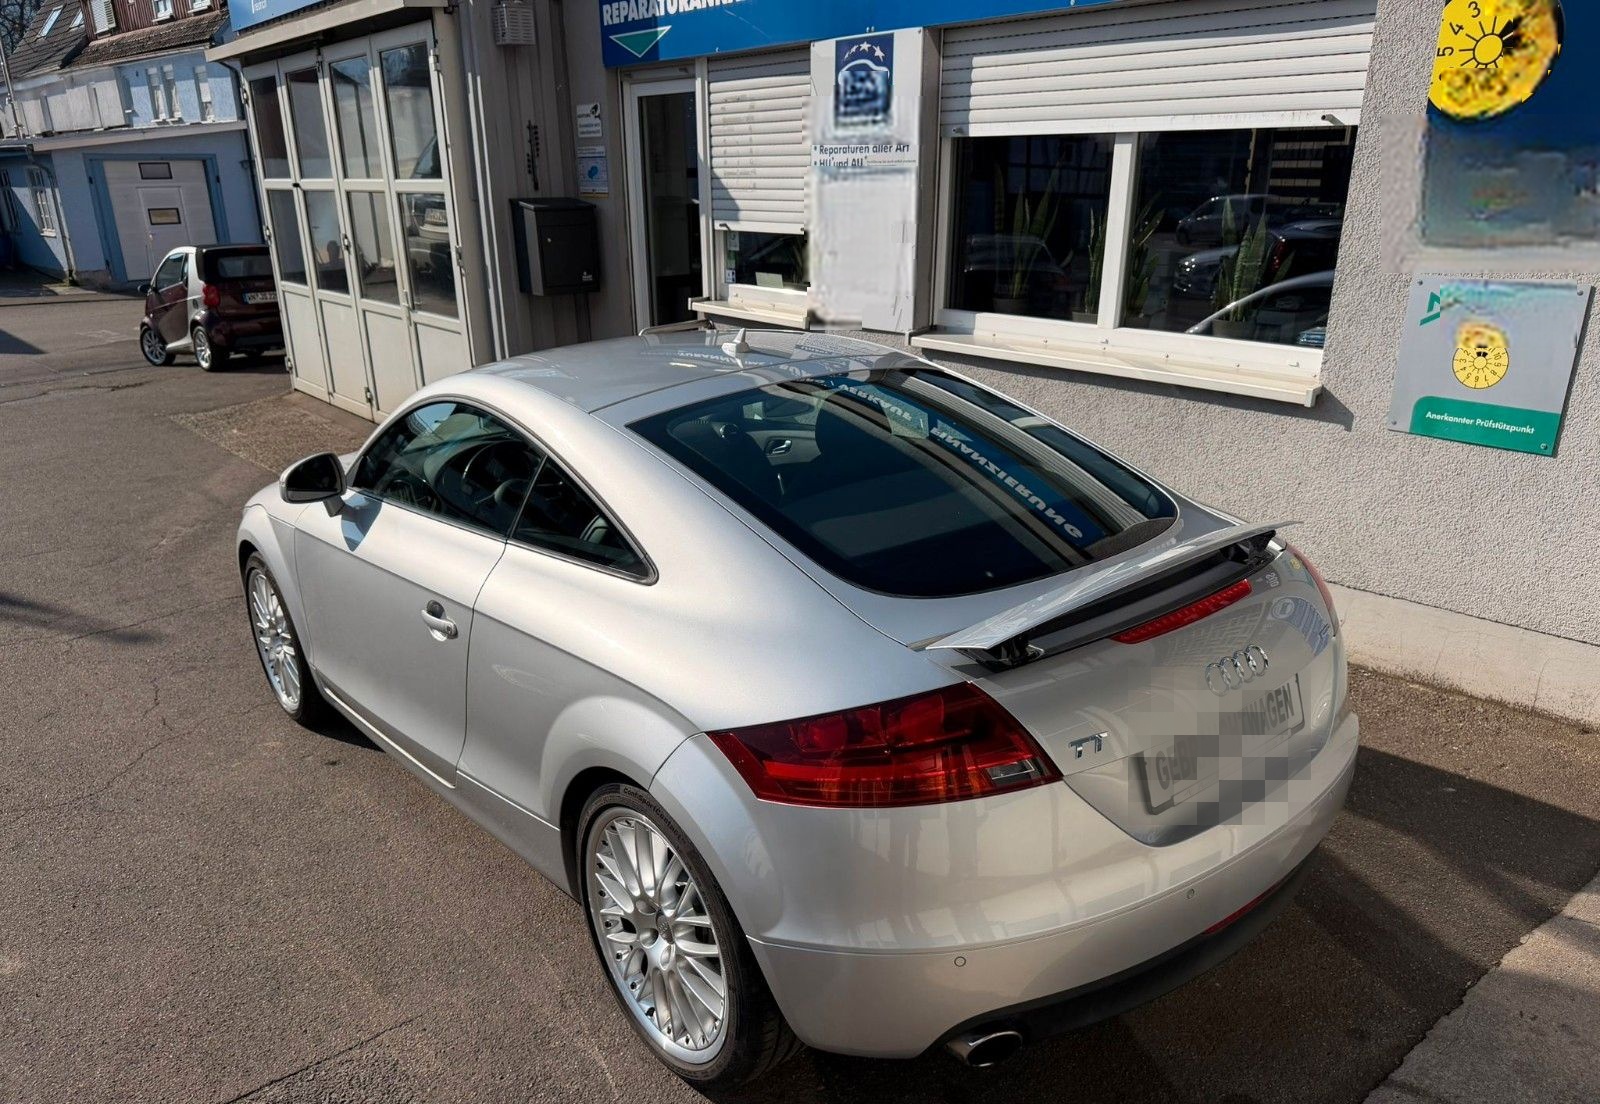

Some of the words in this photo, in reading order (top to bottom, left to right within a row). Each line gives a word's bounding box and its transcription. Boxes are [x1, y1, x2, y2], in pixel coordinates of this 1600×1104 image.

[1467, 1, 1481, 19] 3
[1449, 22, 1464, 36] 4
[1437, 46, 1454, 57] 5
[819, 144, 870, 157] Reparaturen
[1425, 411, 1473, 425] Anerkannter
[1475, 418, 1535, 434] Prüfstützpunkt
[1068, 730, 1109, 760] TT
